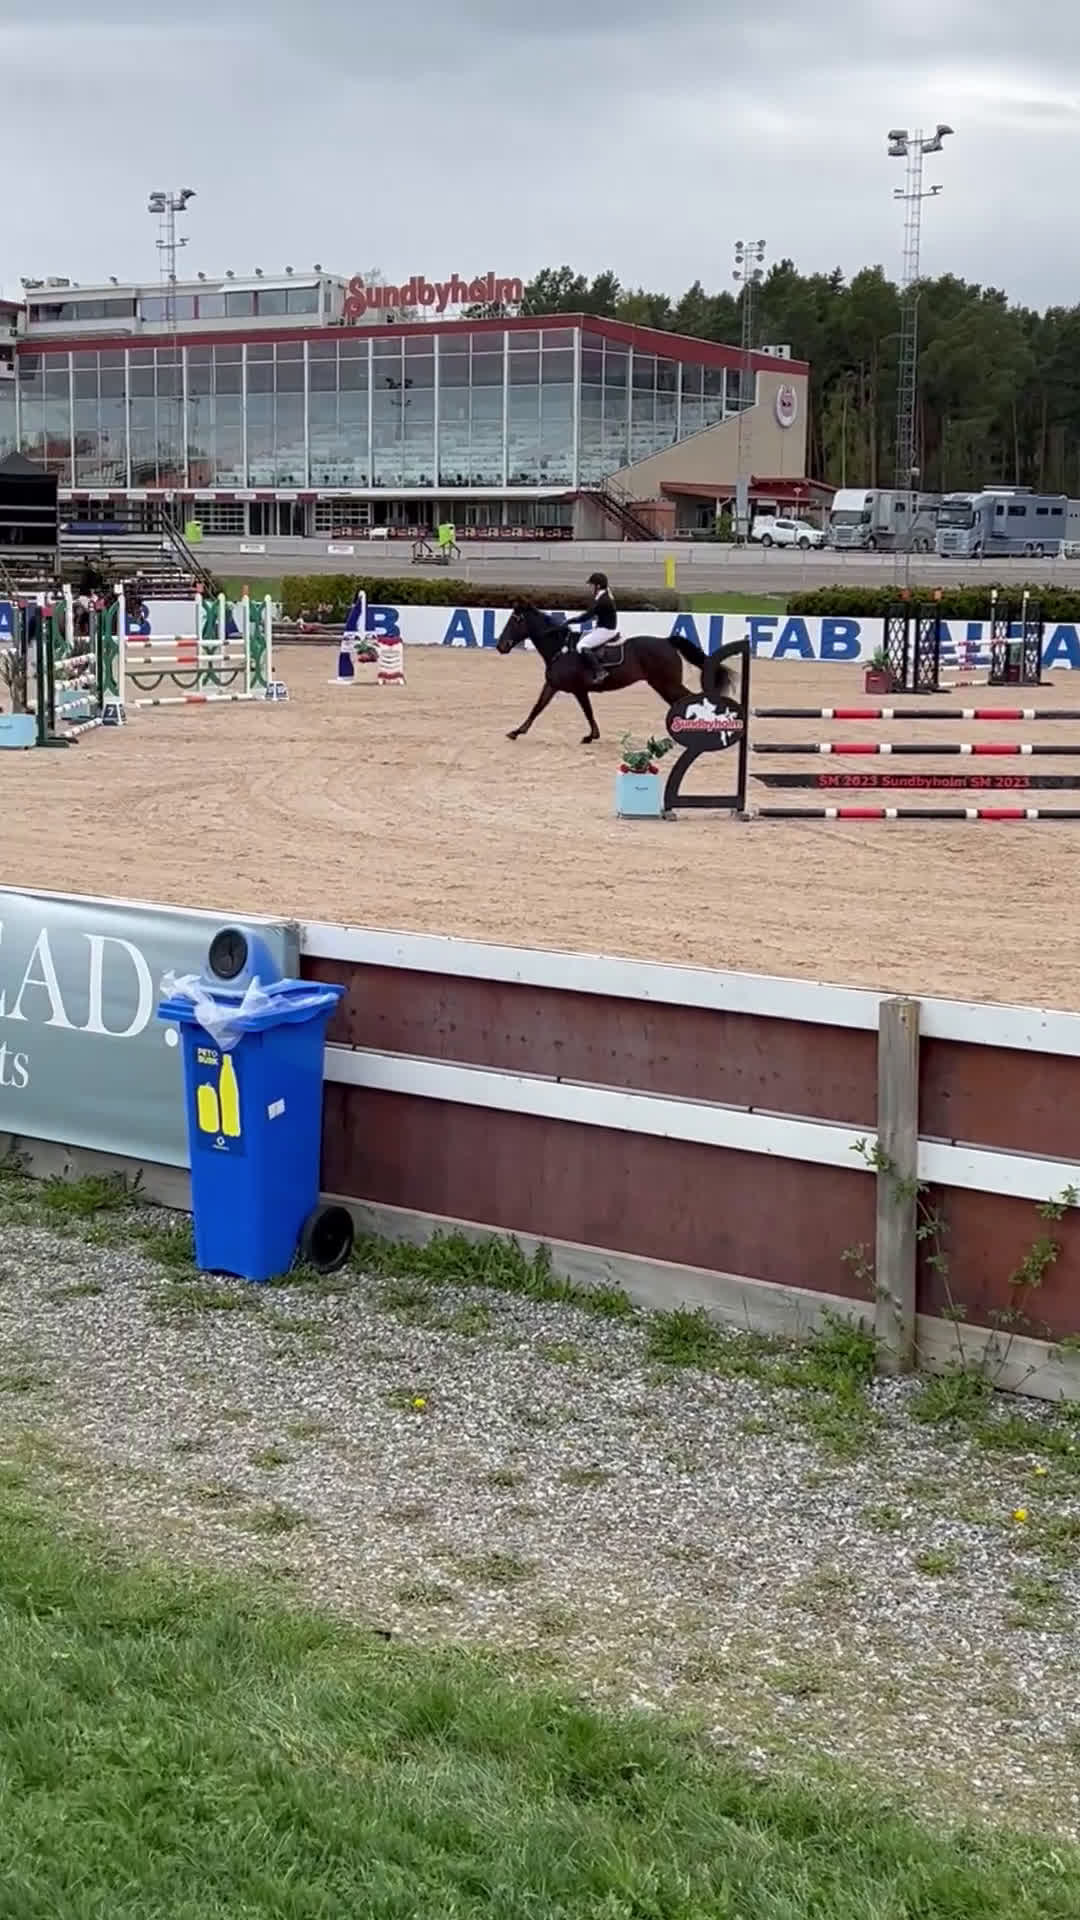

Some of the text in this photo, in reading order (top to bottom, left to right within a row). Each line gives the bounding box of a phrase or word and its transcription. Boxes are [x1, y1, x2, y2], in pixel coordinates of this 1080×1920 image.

[343, 272, 523, 319] Sundbyholm
[672, 716, 744, 732] Sundbyholm
[819, 775, 1031, 788] SM 2023 Sundbyholm SM 2023
[0, 920, 178, 1047] AD.
